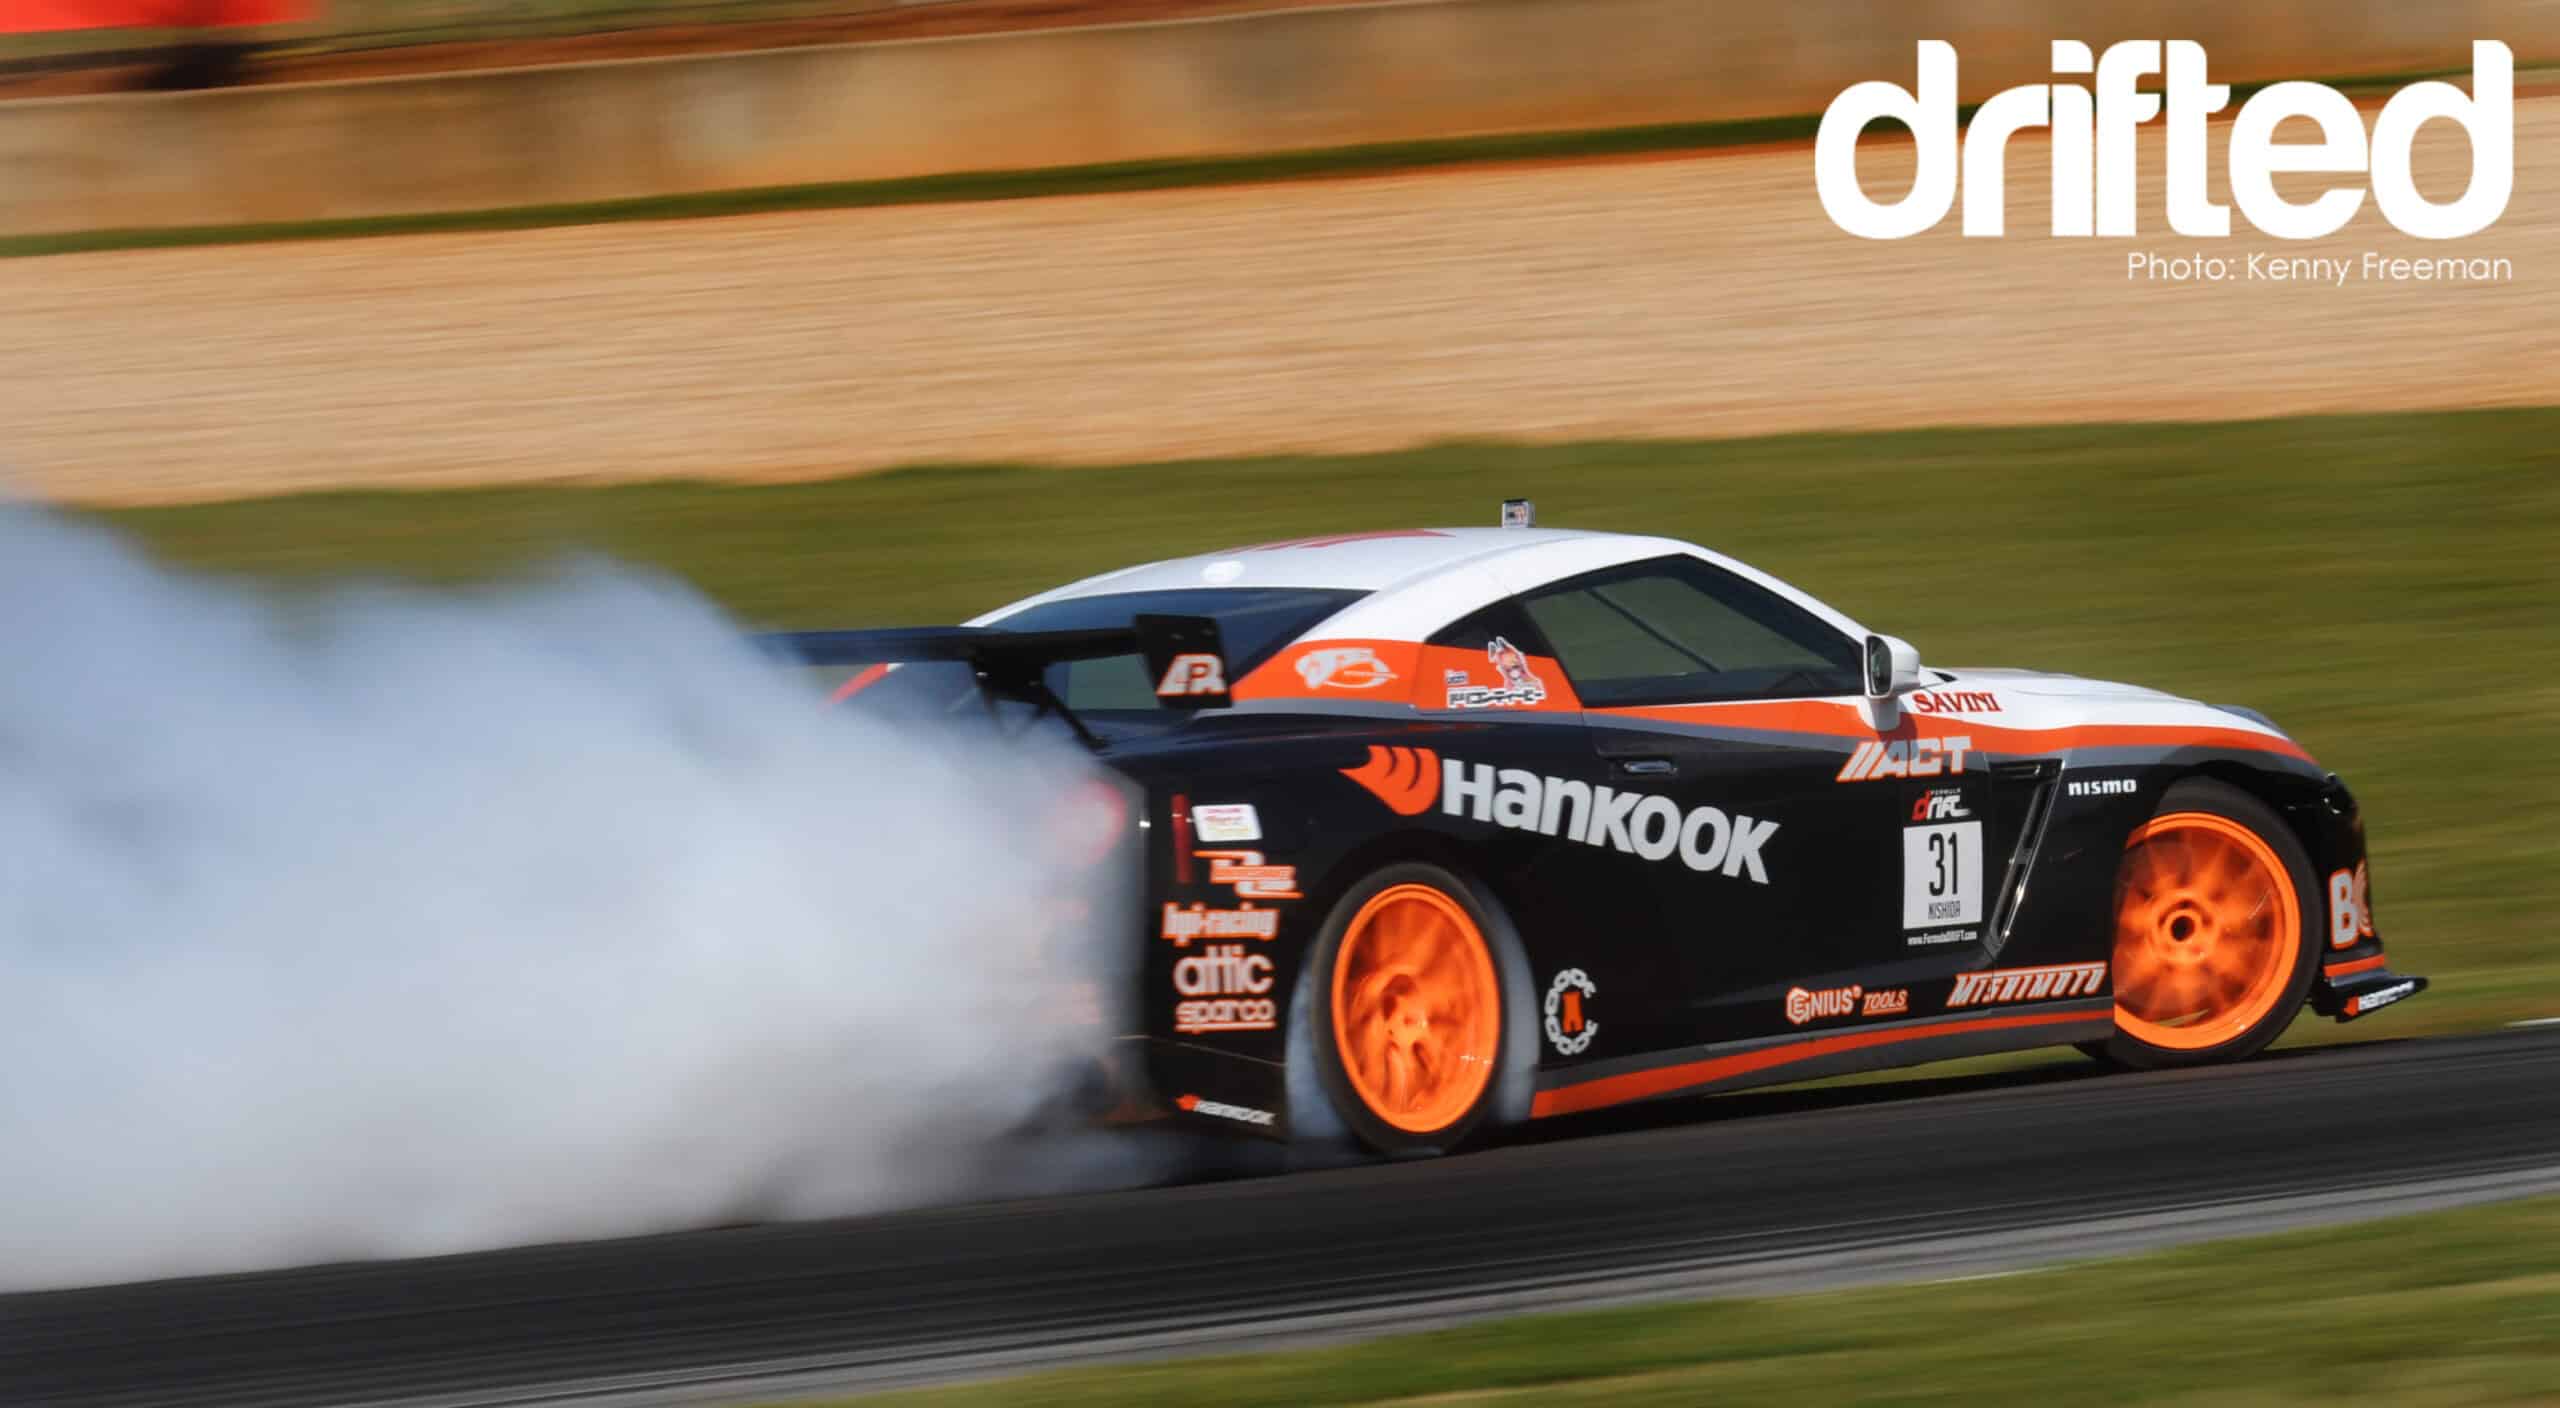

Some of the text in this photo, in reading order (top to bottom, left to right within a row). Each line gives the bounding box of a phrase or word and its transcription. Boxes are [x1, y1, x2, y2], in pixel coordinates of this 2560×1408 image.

[1912, 691, 2003, 714] SAVINI
[1928, 831, 1959, 897] 31
[1174, 945, 1275, 997] attic
[1946, 961, 2108, 1008] MISHIMOTO
[1176, 999, 1277, 1034] sparco
[1862, 989, 1909, 1015] TOOLS
